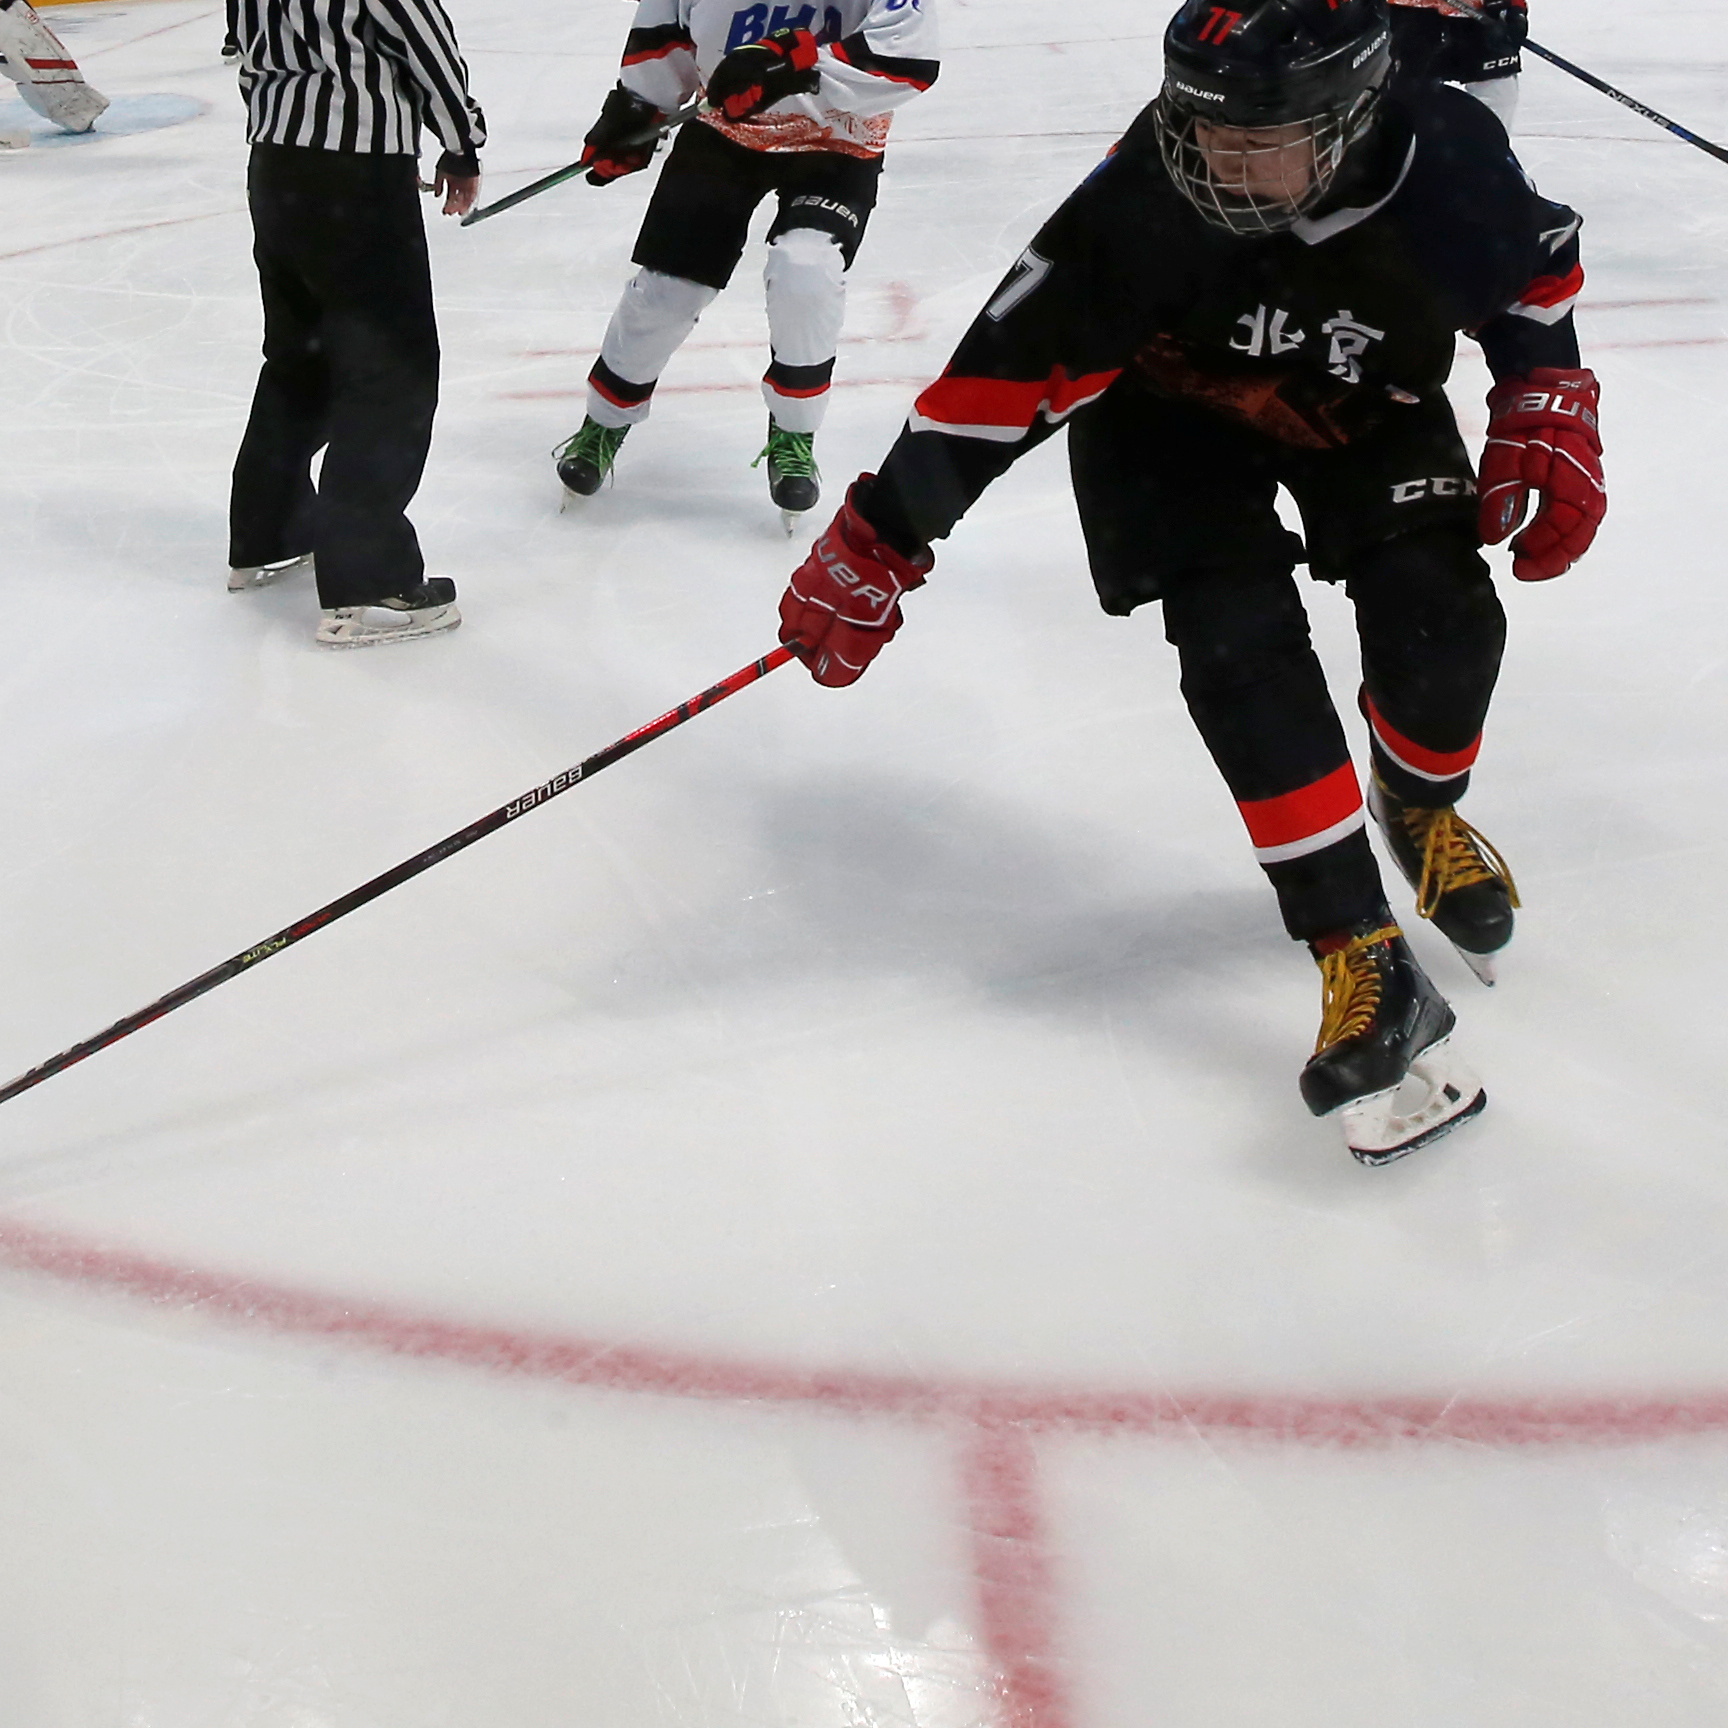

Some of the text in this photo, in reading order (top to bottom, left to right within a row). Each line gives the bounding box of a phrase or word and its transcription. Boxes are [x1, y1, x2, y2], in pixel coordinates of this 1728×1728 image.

[1176, 80, 1226, 103] BAUER
[1606, 87, 1670, 130] NEXUS
[791, 195, 859, 228] BAUER
[1229, 302, 1386, 384] 北京
[505, 765, 584, 820] BAUER
